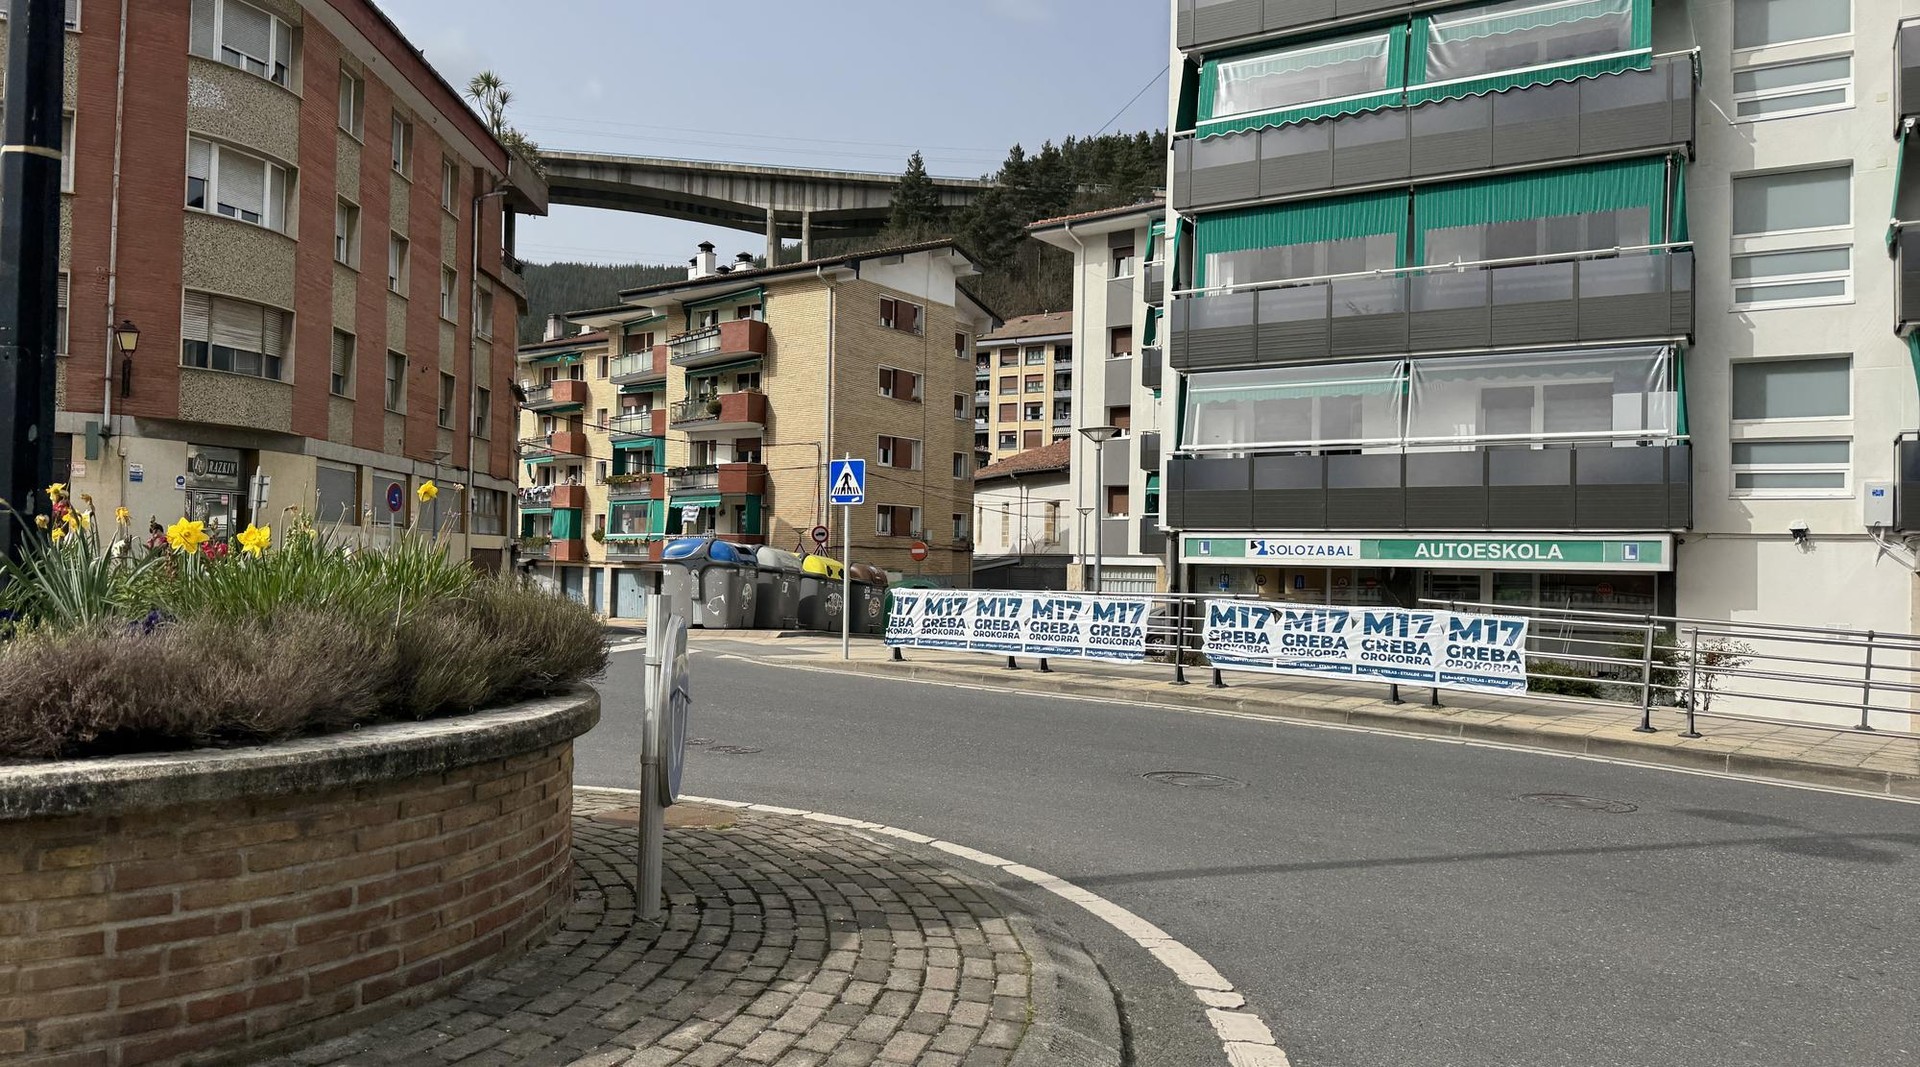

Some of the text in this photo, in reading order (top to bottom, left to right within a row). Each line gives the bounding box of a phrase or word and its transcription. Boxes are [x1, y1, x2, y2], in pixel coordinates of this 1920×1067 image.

[208, 460, 236, 474] RAZKIN
[1269, 544, 1354, 557] SOLOZABAL
[1414, 542, 1564, 560] AUTOESKOLA
[895, 596, 919, 616] 17
[924, 596, 969, 616] M17
[976, 597, 1023, 618] M17
[1031, 598, 1082, 621] M17
[1092, 601, 1146, 624] M17
[889, 616, 915, 628] EBA
[922, 617, 967, 629] GREBA
[974, 618, 1021, 632] GREBA
[1210, 604, 1273, 629] M17
[1284, 609, 1350, 634] M17
[1363, 611, 1434, 639] M17
[888, 627, 913, 635] KORRA
[920, 628, 966, 636] OROKORRA
[973, 630, 1020, 639] OROKORRA
[1030, 621, 1081, 635] GREBA
[1089, 624, 1144, 638] GREBA
[1448, 616, 1525, 647] M17
[1029, 633, 1080, 643] OROKORRA
[1088, 636, 1143, 647] OROKORRA
[1208, 629, 1271, 646] GREBA
[1282, 633, 1349, 650] GREBA
[1361, 638, 1433, 657] GREBA
[1446, 644, 1522, 665] GREBA
[1360, 651, 1432, 666] OROKORRA
